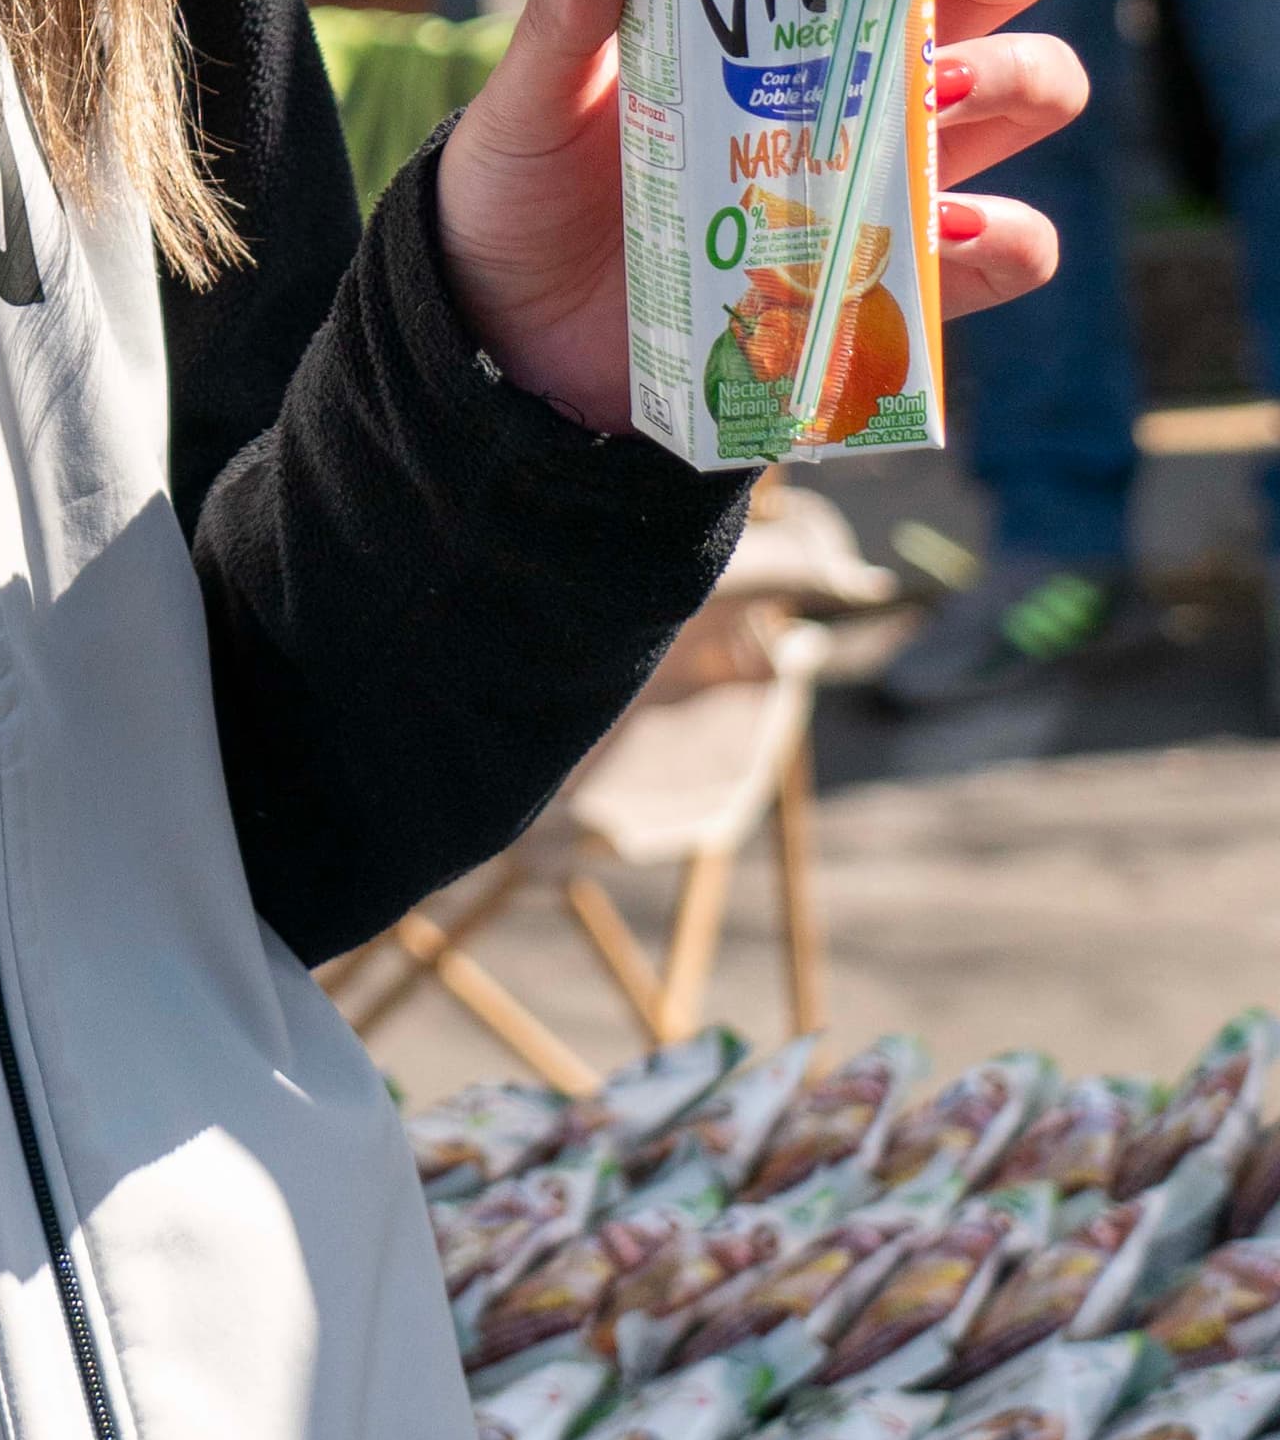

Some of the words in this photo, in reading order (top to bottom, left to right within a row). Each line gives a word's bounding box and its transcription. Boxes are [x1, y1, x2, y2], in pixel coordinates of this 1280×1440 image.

[760, 71, 788, 86] Con
[749, 87, 801, 107] Doble
[719, 380, 770, 400] Néctar
[719, 397, 780, 419] Naranja
[876, 389, 926, 415] 190ml
